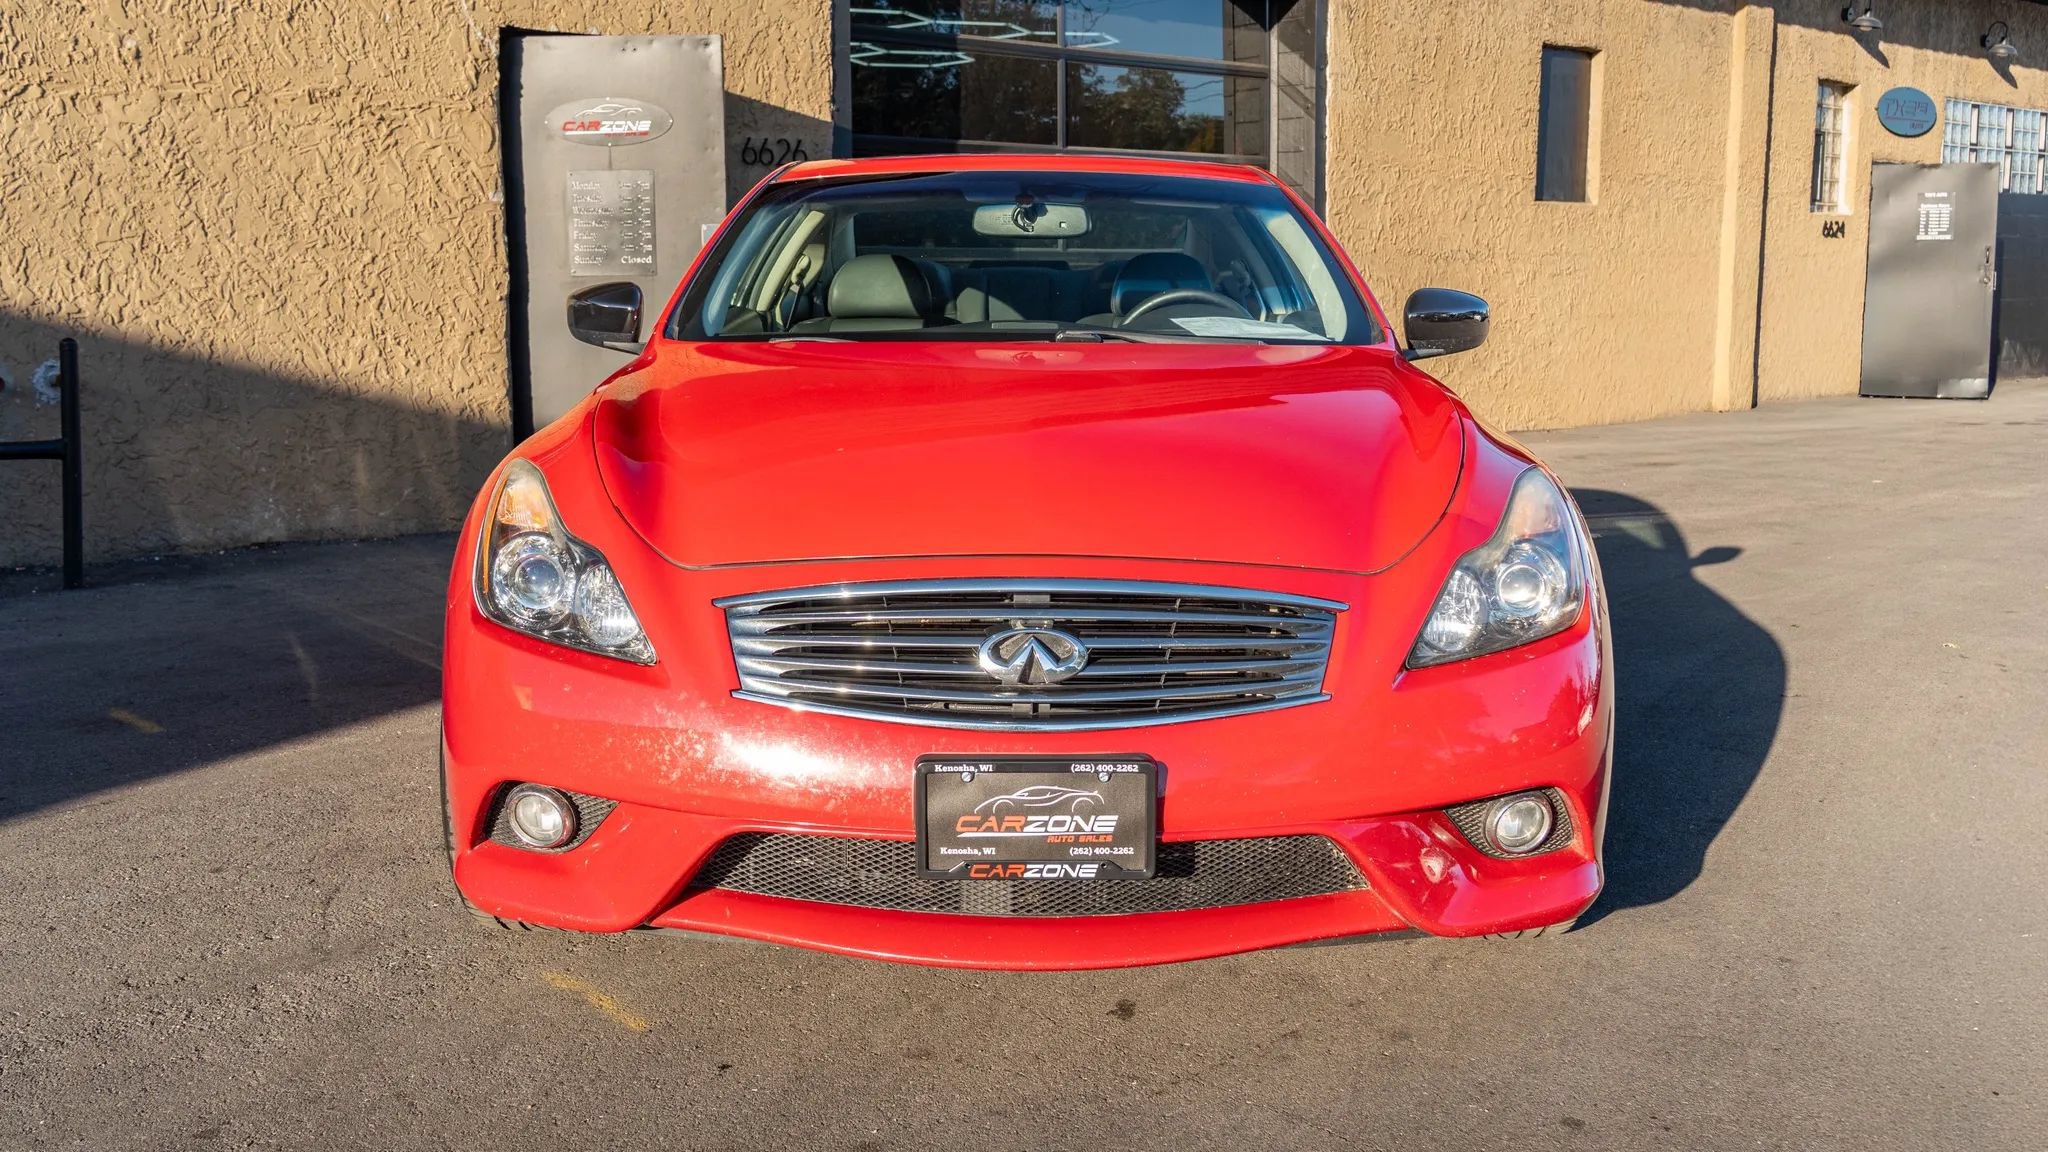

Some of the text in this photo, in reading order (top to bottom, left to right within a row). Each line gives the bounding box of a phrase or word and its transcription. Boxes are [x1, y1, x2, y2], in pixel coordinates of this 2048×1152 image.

[562, 120, 652, 132] CARZONE
[742, 137, 808, 166] 6626
[1822, 219, 1845, 239] 6624
[620, 255, 653, 264] Closed
[934, 764, 994, 773] Kenosha, WI
[1070, 763, 1139, 774] (262) 400-2262
[955, 815, 1119, 832] CARZONE
[1047, 834, 1113, 843] AUTO SALES
[940, 847, 996, 856] Kenosha, WI
[1069, 846, 1135, 857] (262) 400-2262
[969, 863, 1099, 878] CARZONE
